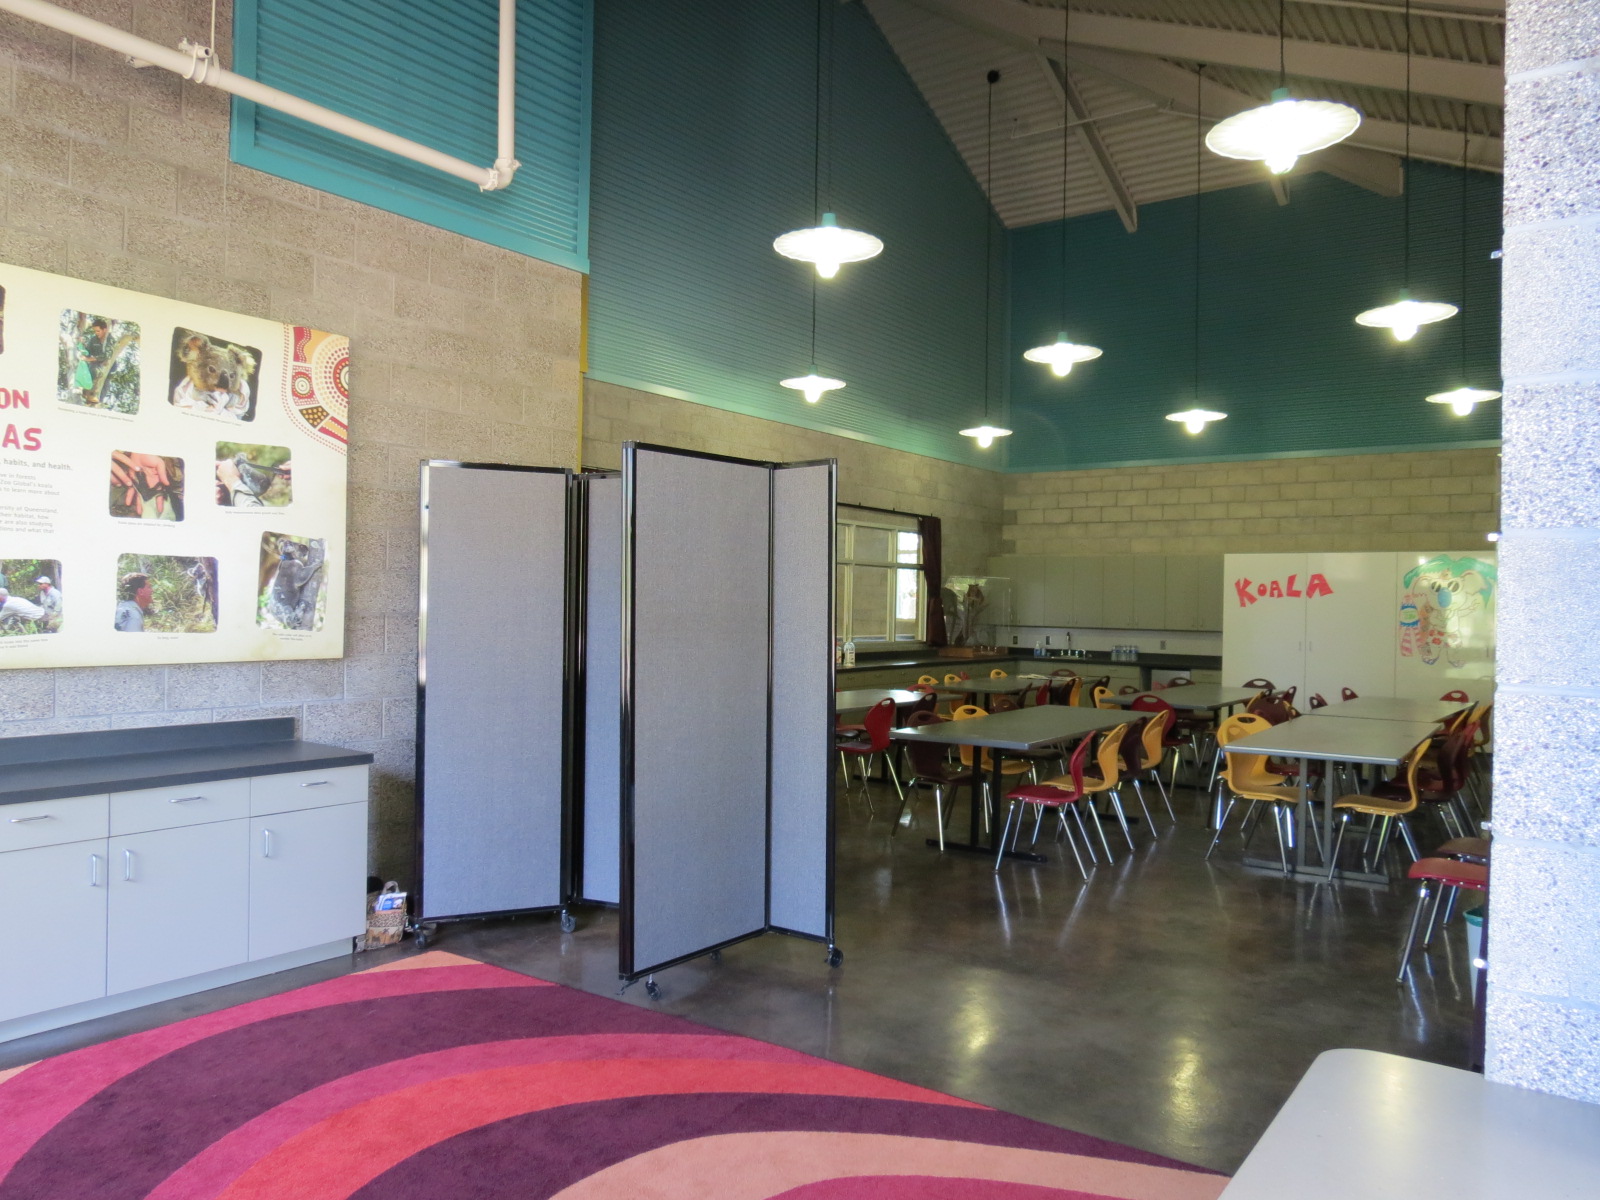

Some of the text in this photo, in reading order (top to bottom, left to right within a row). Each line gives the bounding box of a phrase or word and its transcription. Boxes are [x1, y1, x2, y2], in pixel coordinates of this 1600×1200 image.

[0, 388, 29, 409] ON
[2, 423, 42, 451] AS
[4, 458, 29, 467] habits,
[48, 461, 73, 470] health.
[1234, 573, 1334, 608] KOALA
